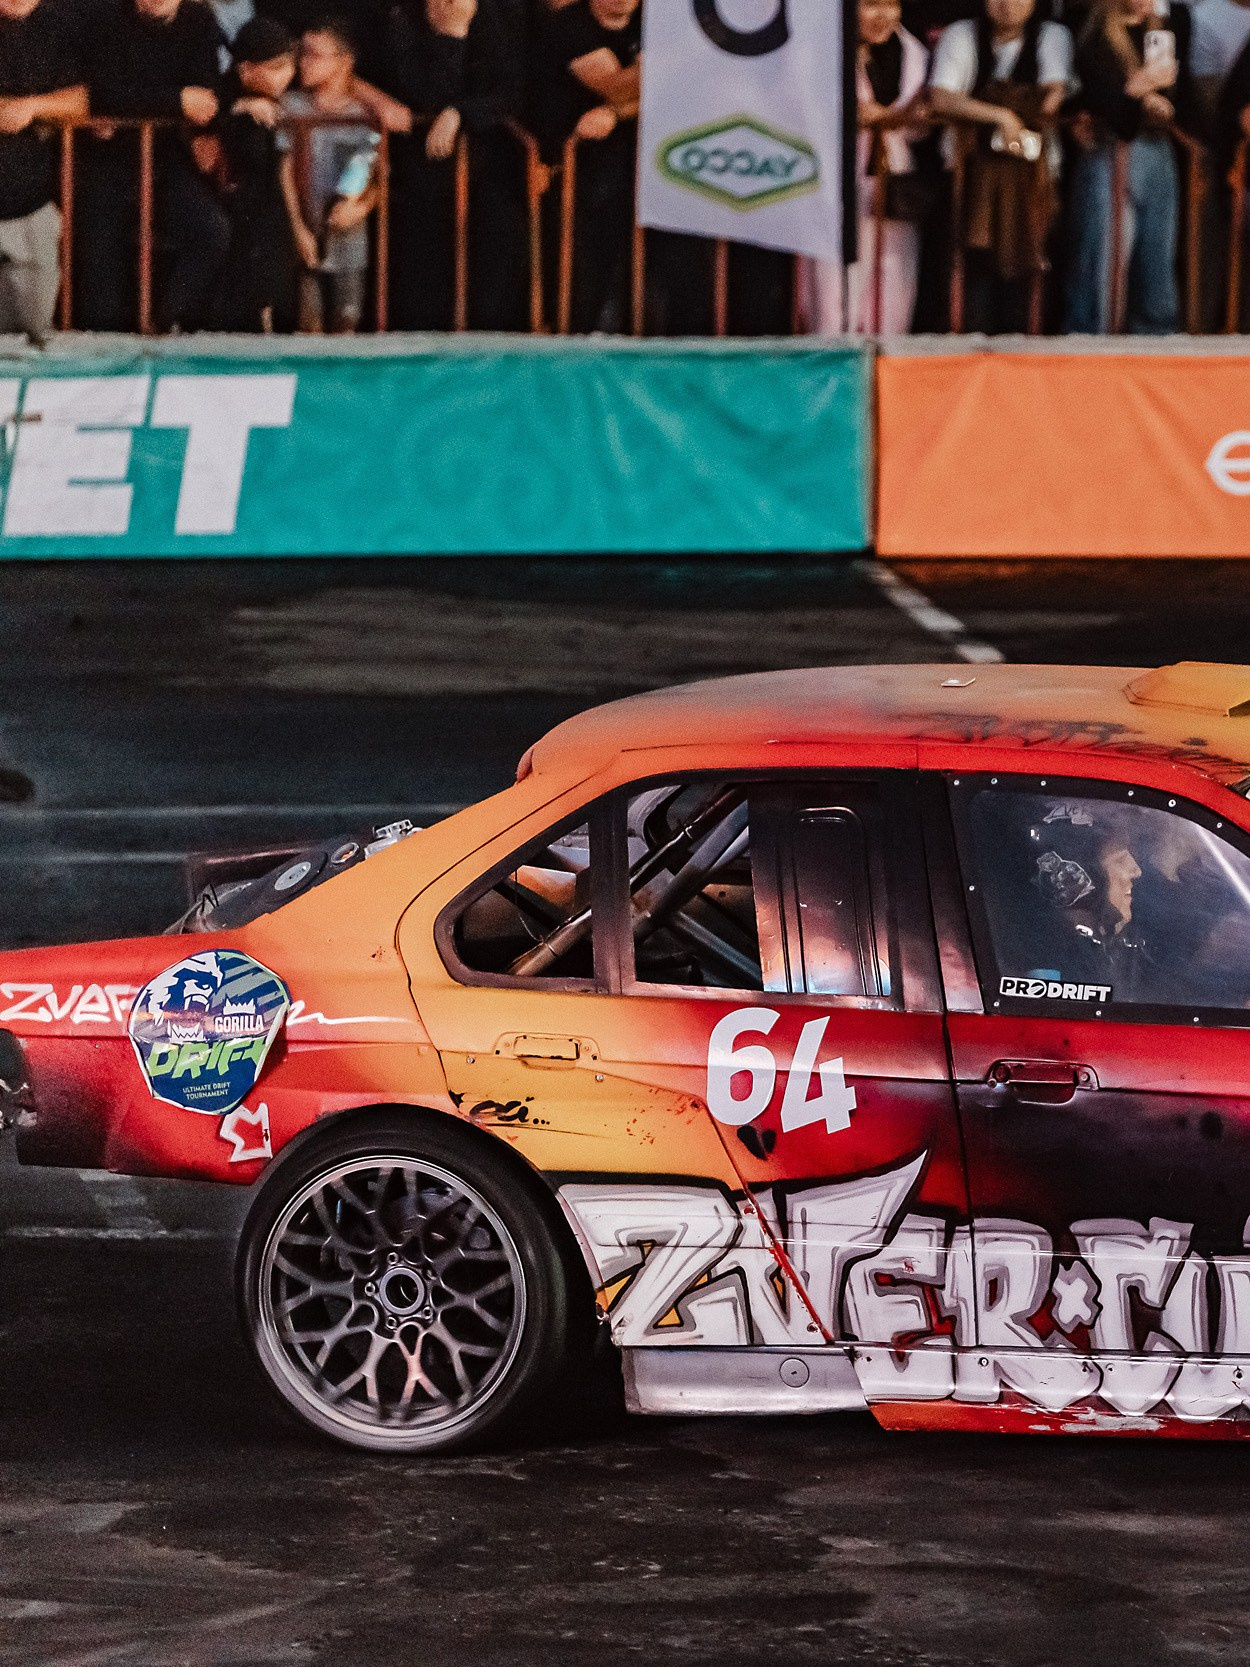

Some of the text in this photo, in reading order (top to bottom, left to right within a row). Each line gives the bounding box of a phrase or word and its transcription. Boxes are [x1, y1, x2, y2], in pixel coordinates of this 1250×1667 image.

[0, 374, 296, 535] ET
[214, 1014, 264, 1034] GORILLA
[707, 1007, 857, 1135] 64
[182, 1081, 231, 1094] ULTIMATE DRIFT
[186, 1089, 229, 1100] TOURNAMENT
